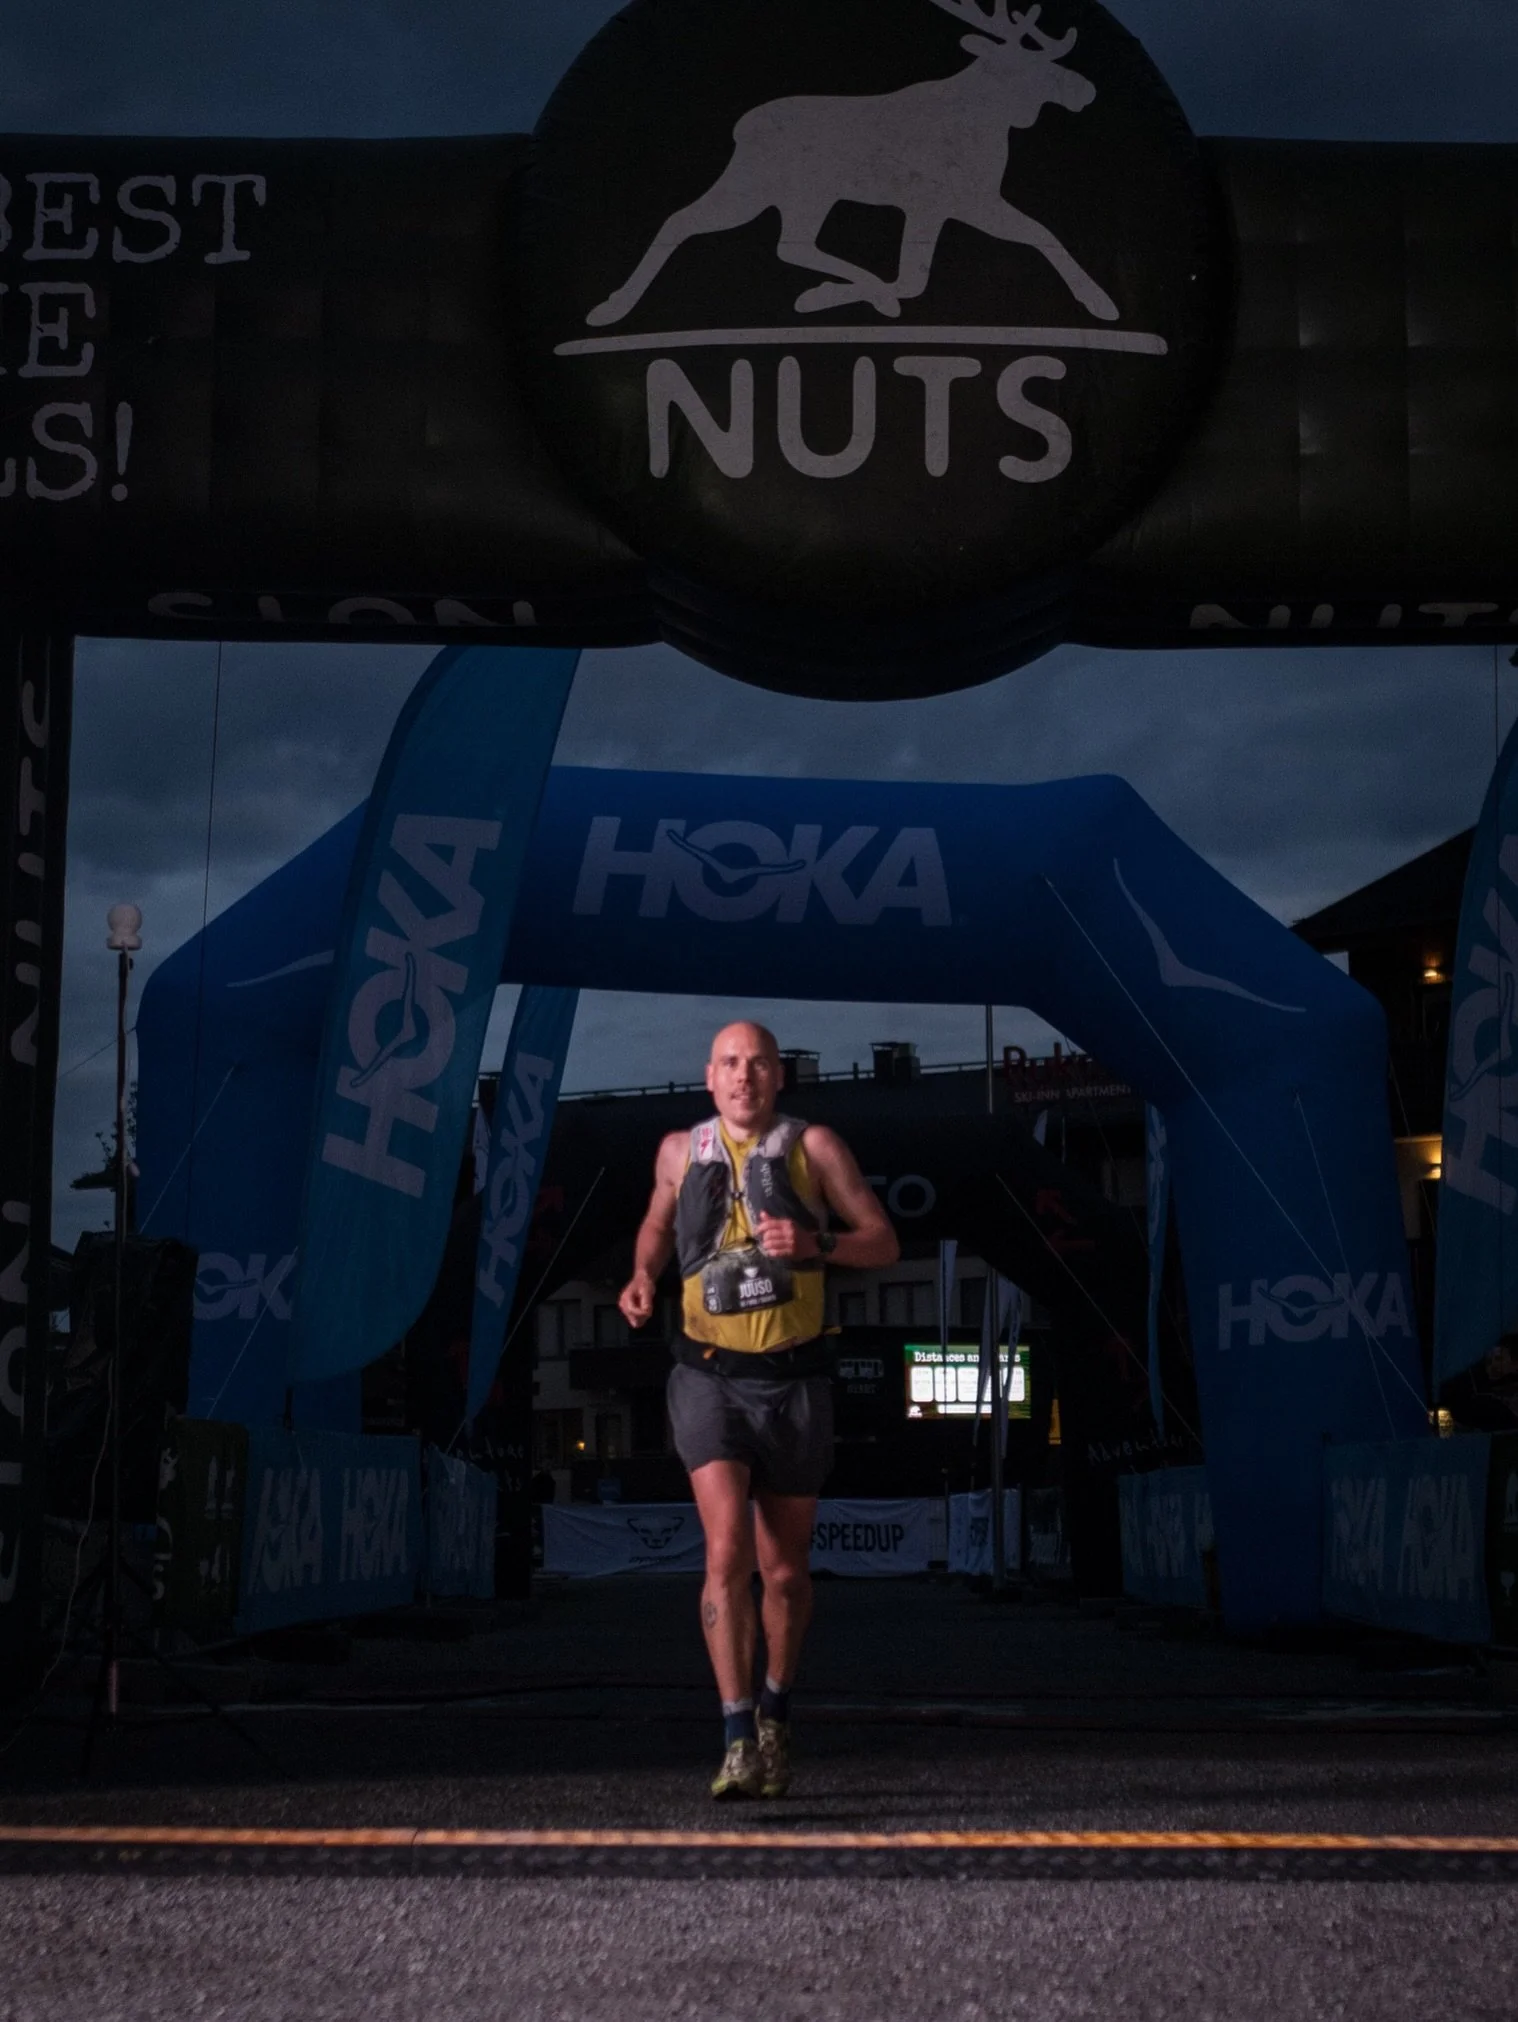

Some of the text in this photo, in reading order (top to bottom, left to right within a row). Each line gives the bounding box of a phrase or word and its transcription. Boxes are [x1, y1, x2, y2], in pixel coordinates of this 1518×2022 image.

[0, 172, 266, 264] EST
[0, 281, 96, 378] E
[0, 401, 133, 501] S!
[646, 355, 1072, 484] NUTS
[572, 815, 952, 927] HOKA
[321, 813, 502, 1199] HOKA
[478, 1051, 555, 1309] HOKA
[192, 1251, 299, 1321] OK
[1217, 1272, 1413, 1351] HOKA
[810, 1522, 904, 1554] SPEEDUP
